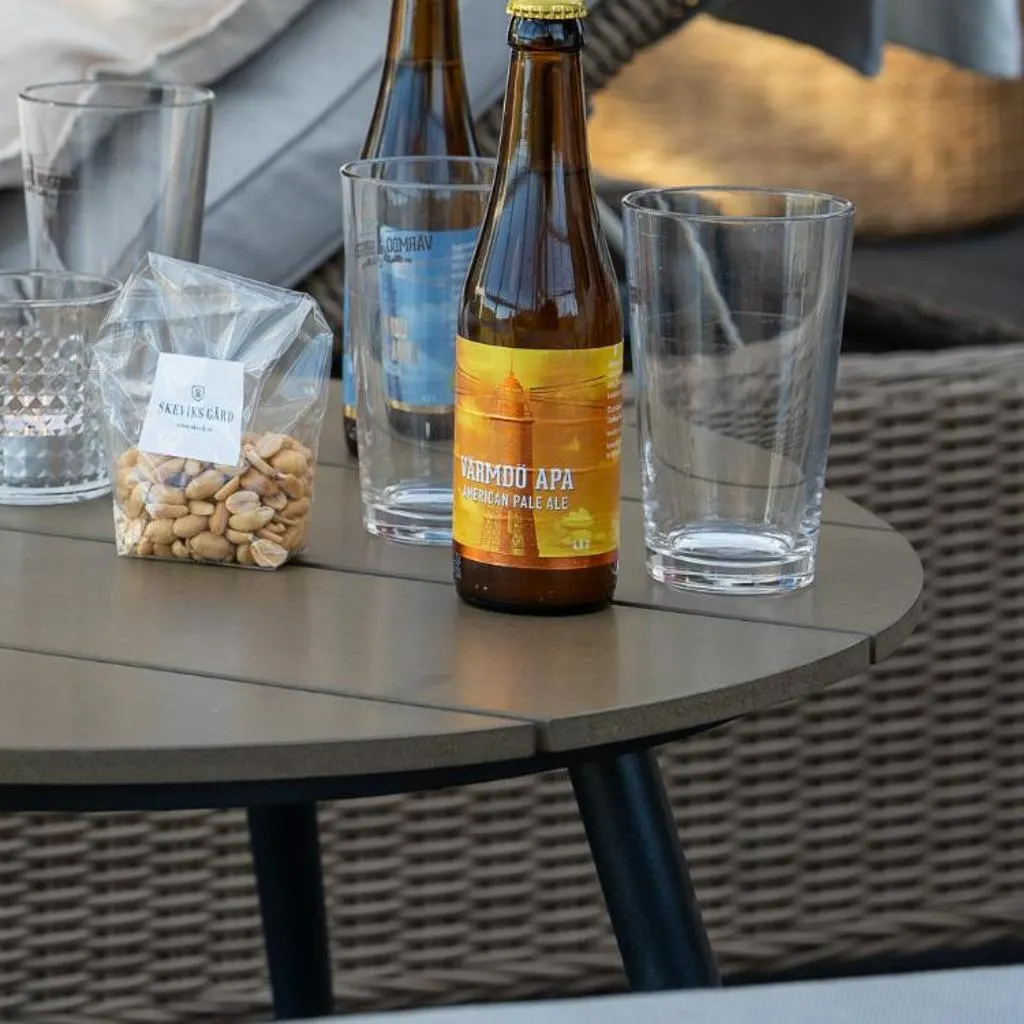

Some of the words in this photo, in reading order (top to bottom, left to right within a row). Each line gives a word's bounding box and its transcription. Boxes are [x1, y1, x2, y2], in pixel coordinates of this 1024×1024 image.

[460, 455, 527, 489] VÄRMDÖ
[534, 467, 575, 490] APA
[462, 486, 509, 507] AMERICAN
[512, 495, 543, 510] PALE
[545, 496, 569, 510] ALE
